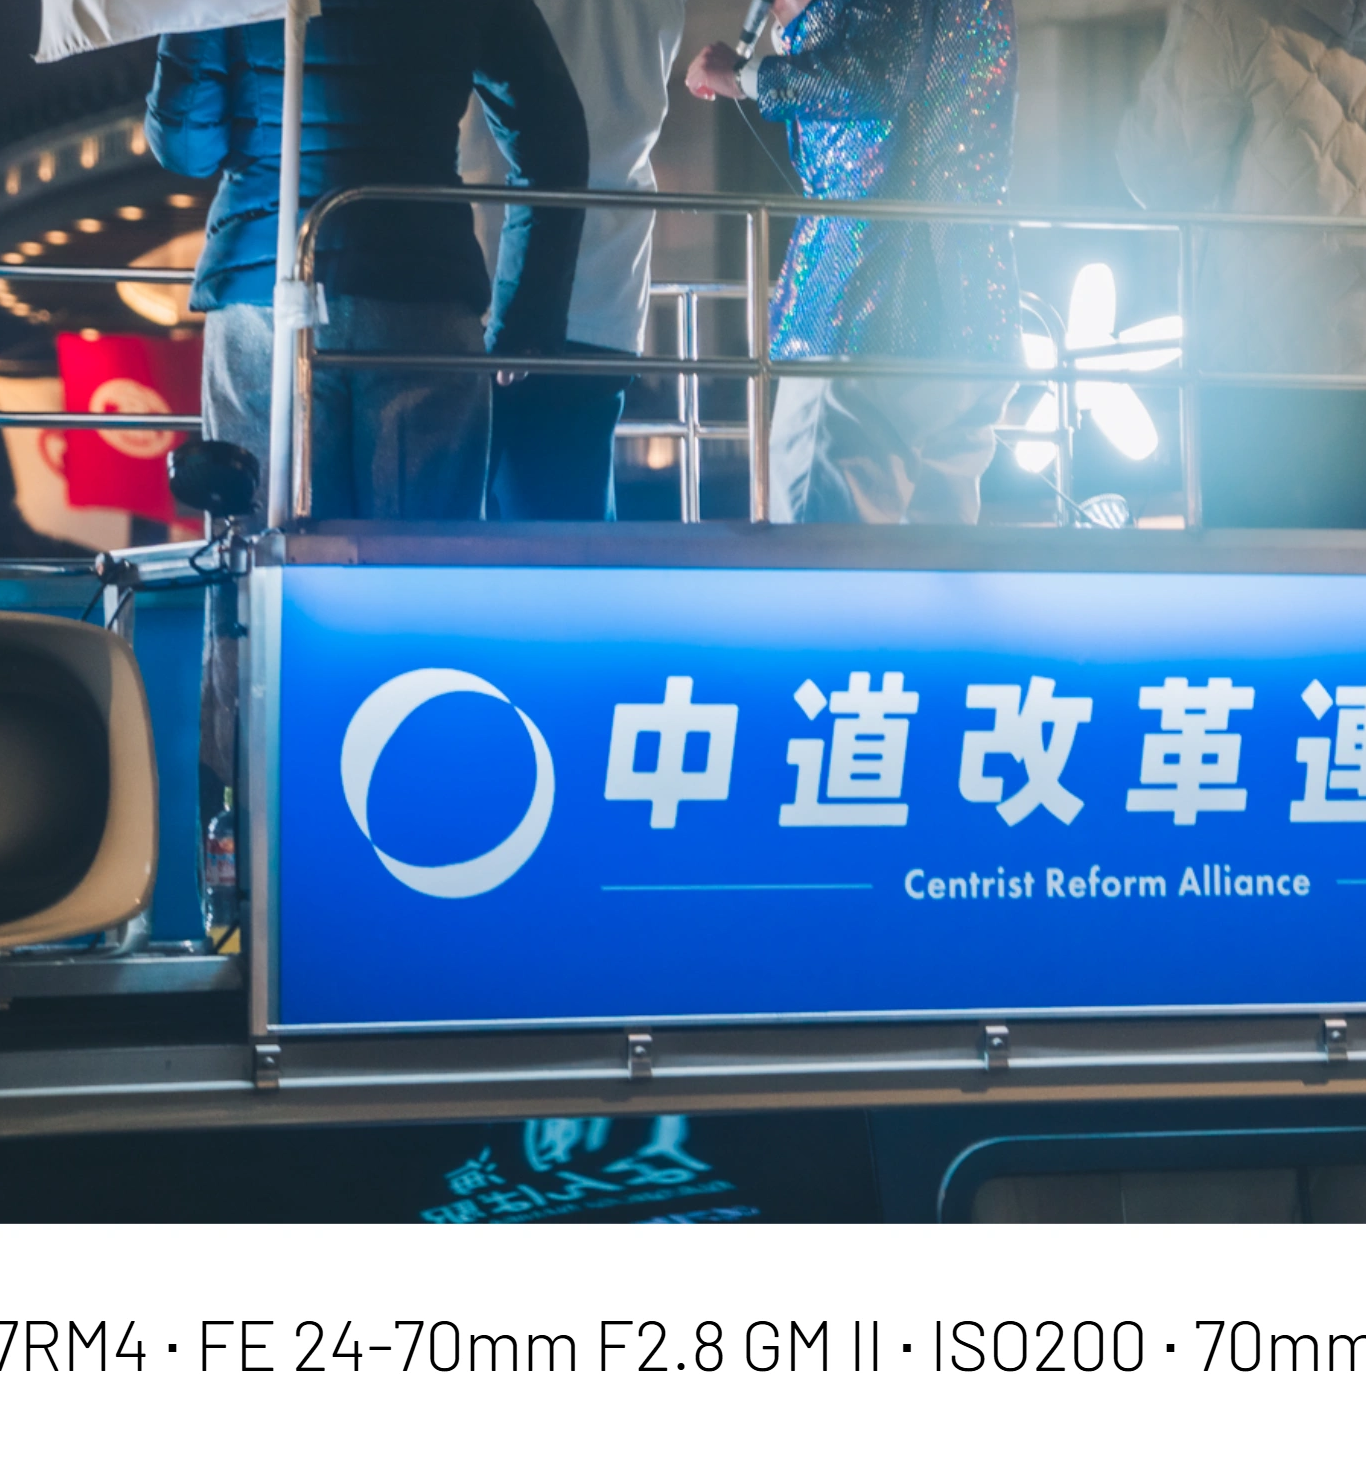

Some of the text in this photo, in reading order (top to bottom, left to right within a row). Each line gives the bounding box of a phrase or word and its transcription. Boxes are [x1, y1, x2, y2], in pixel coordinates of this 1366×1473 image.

[904, 864, 1311, 900] Centrist Reform Alliance
